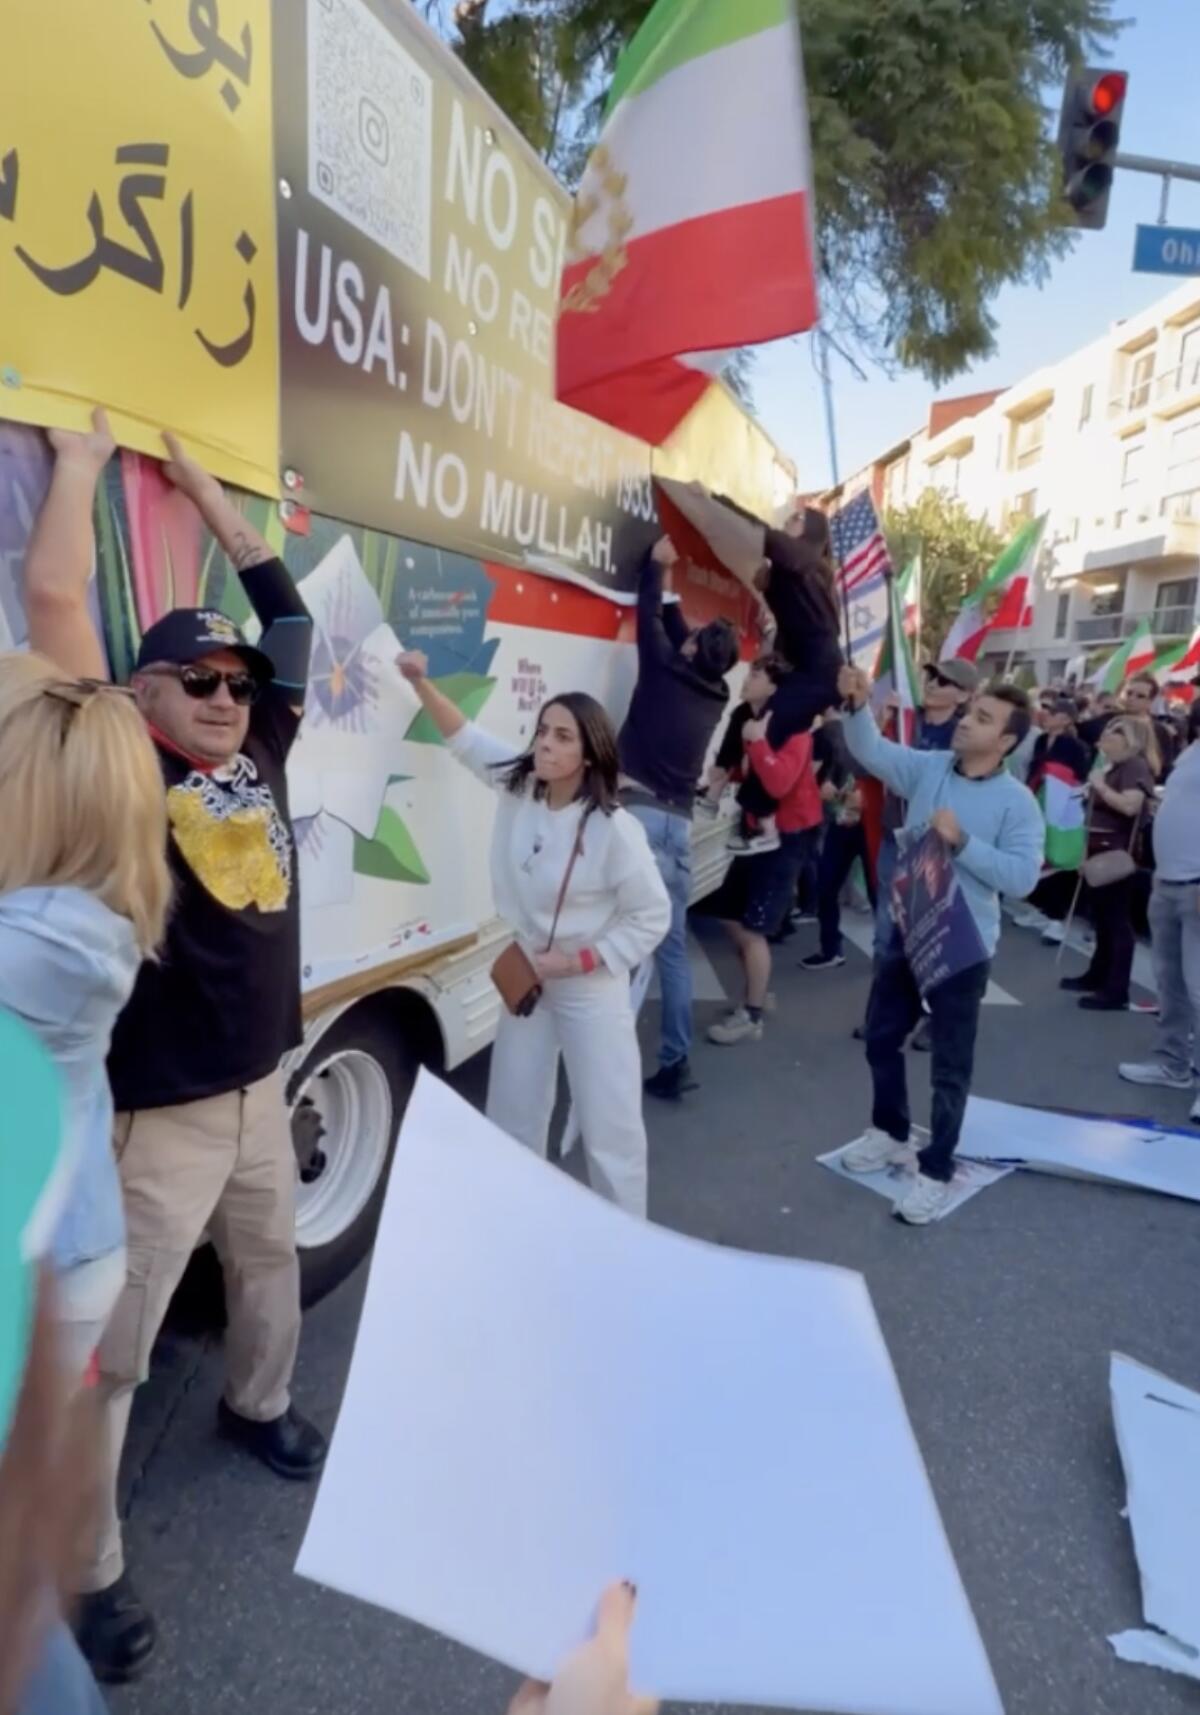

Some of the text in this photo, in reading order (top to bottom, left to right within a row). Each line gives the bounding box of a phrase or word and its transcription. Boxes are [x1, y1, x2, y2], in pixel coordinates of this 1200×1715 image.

[444, 232, 499, 324] NO
[446, 100, 566, 301] NO S
[294, 228, 408, 392] USA:
[422, 316, 522, 450] DON'T
[528, 390, 614, 499] REPEAT
[394, 430, 617, 575] NO MULLAH.
